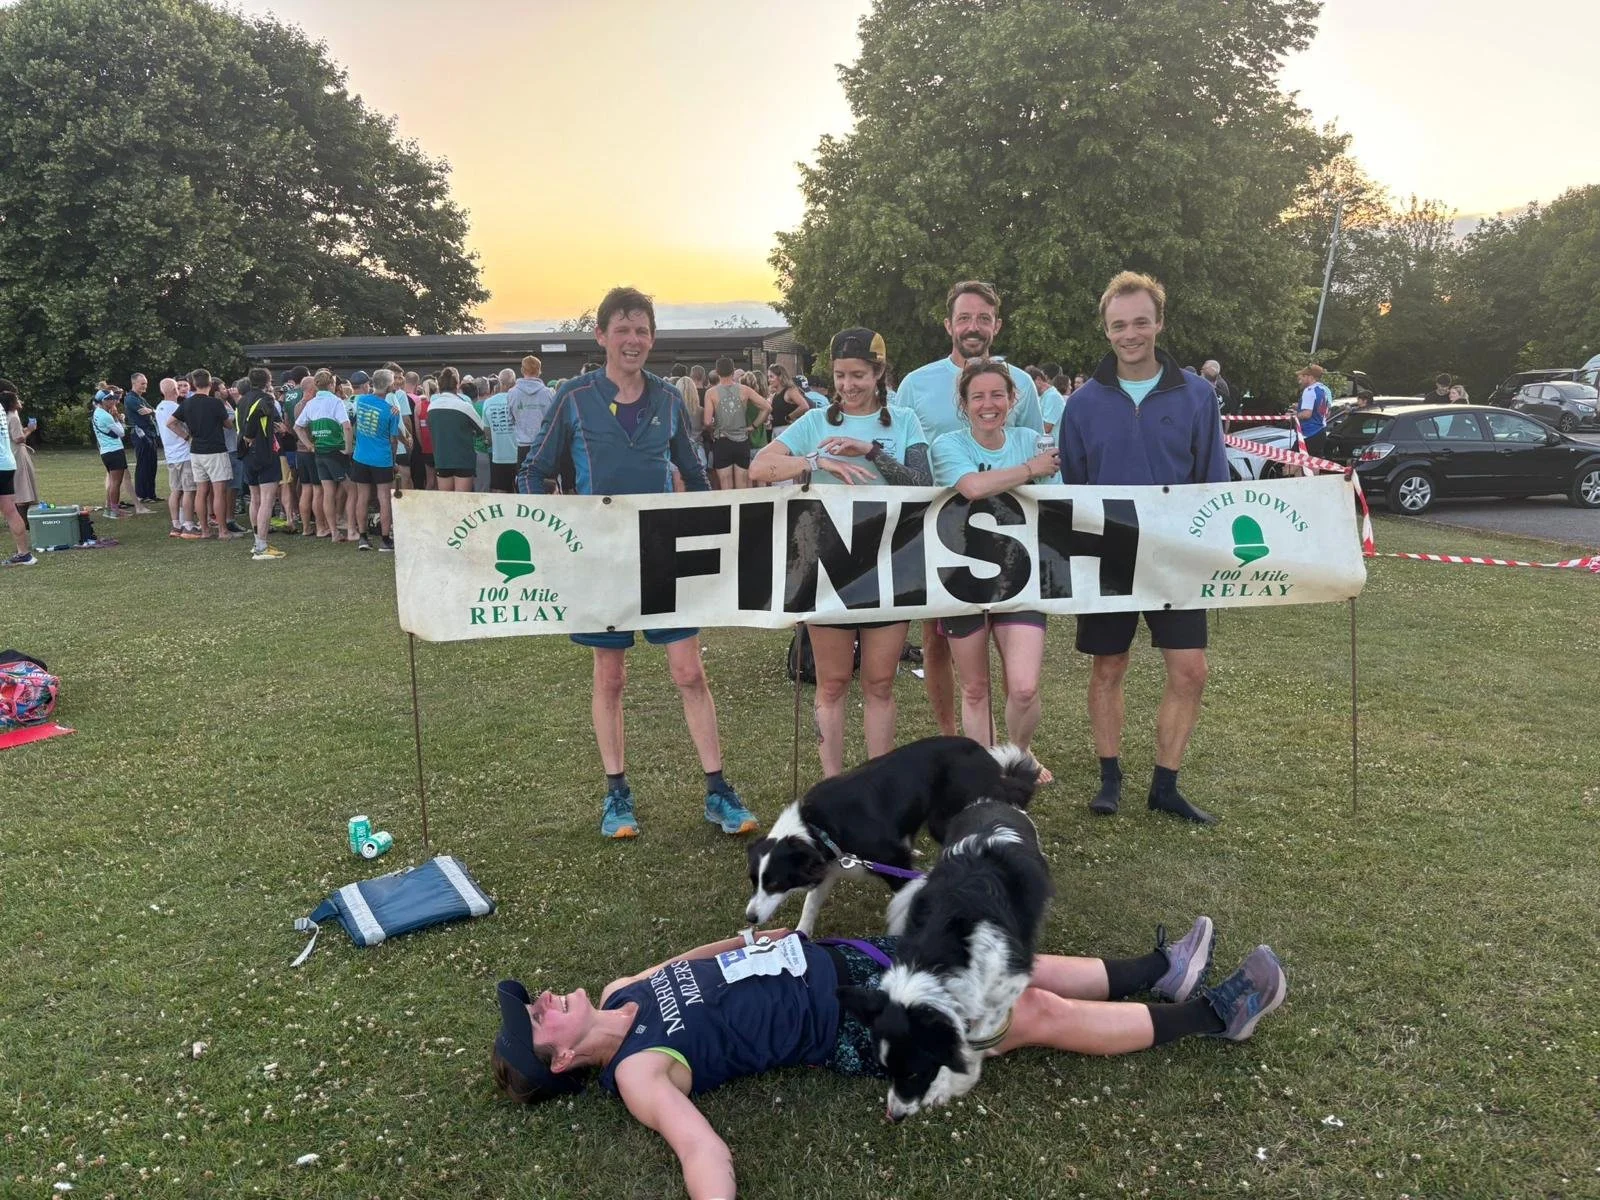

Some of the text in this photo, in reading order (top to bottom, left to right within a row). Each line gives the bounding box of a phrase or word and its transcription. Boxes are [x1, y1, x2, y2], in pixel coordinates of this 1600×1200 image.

[285, 392, 298, 402] 250
[1188, 489, 1310, 538] SOUTH DOWNS
[447, 504, 584, 553] SOUTH DOWNS
[639, 494, 1138, 615] FINISH
[1210, 569, 1289, 582] 100 Mile
[478, 587, 559, 603] 100 Mile
[1200, 582, 1295, 598] RELAY
[469, 605, 568, 625] RELAY
[670, 959, 704, 1007] MILERS
